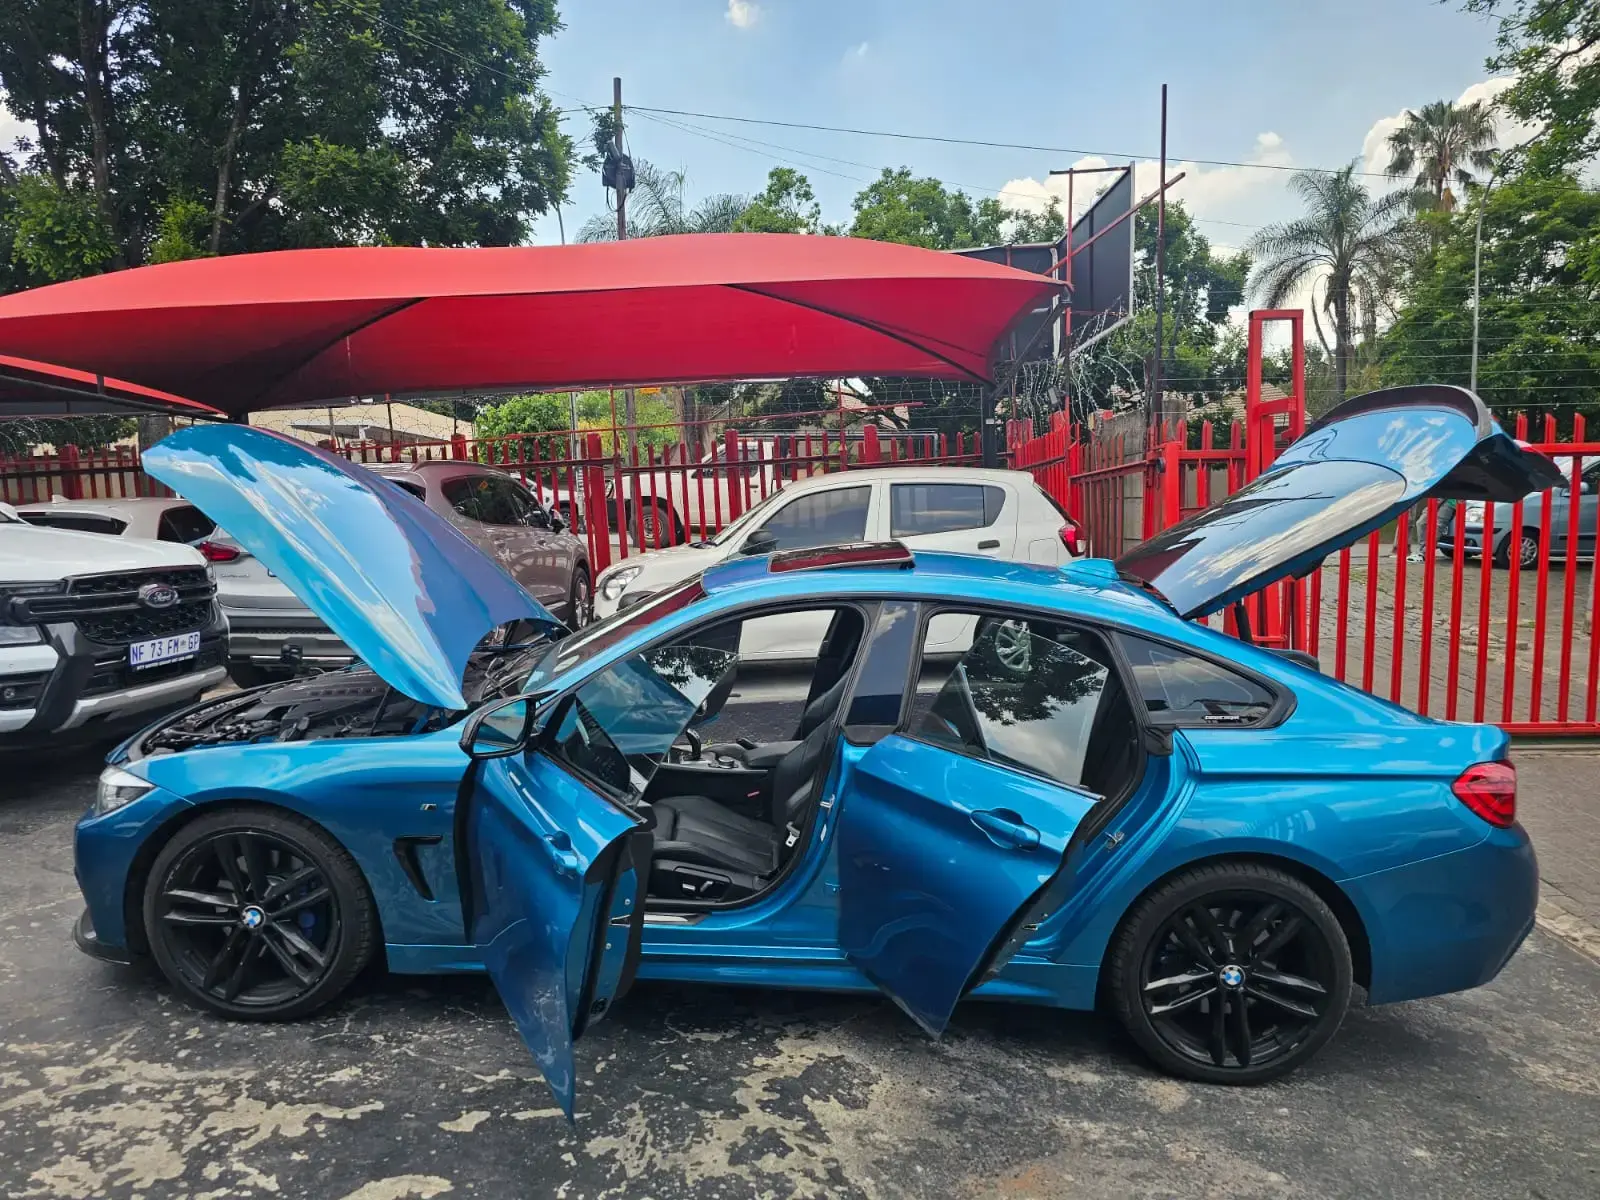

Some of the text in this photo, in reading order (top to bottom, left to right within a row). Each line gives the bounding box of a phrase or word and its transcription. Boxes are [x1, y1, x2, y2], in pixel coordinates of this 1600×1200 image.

[132, 645, 145, 663] NF
[151, 641, 163, 659] 73
[167, 638, 180, 655] FM
[188, 634, 199, 650] GP
